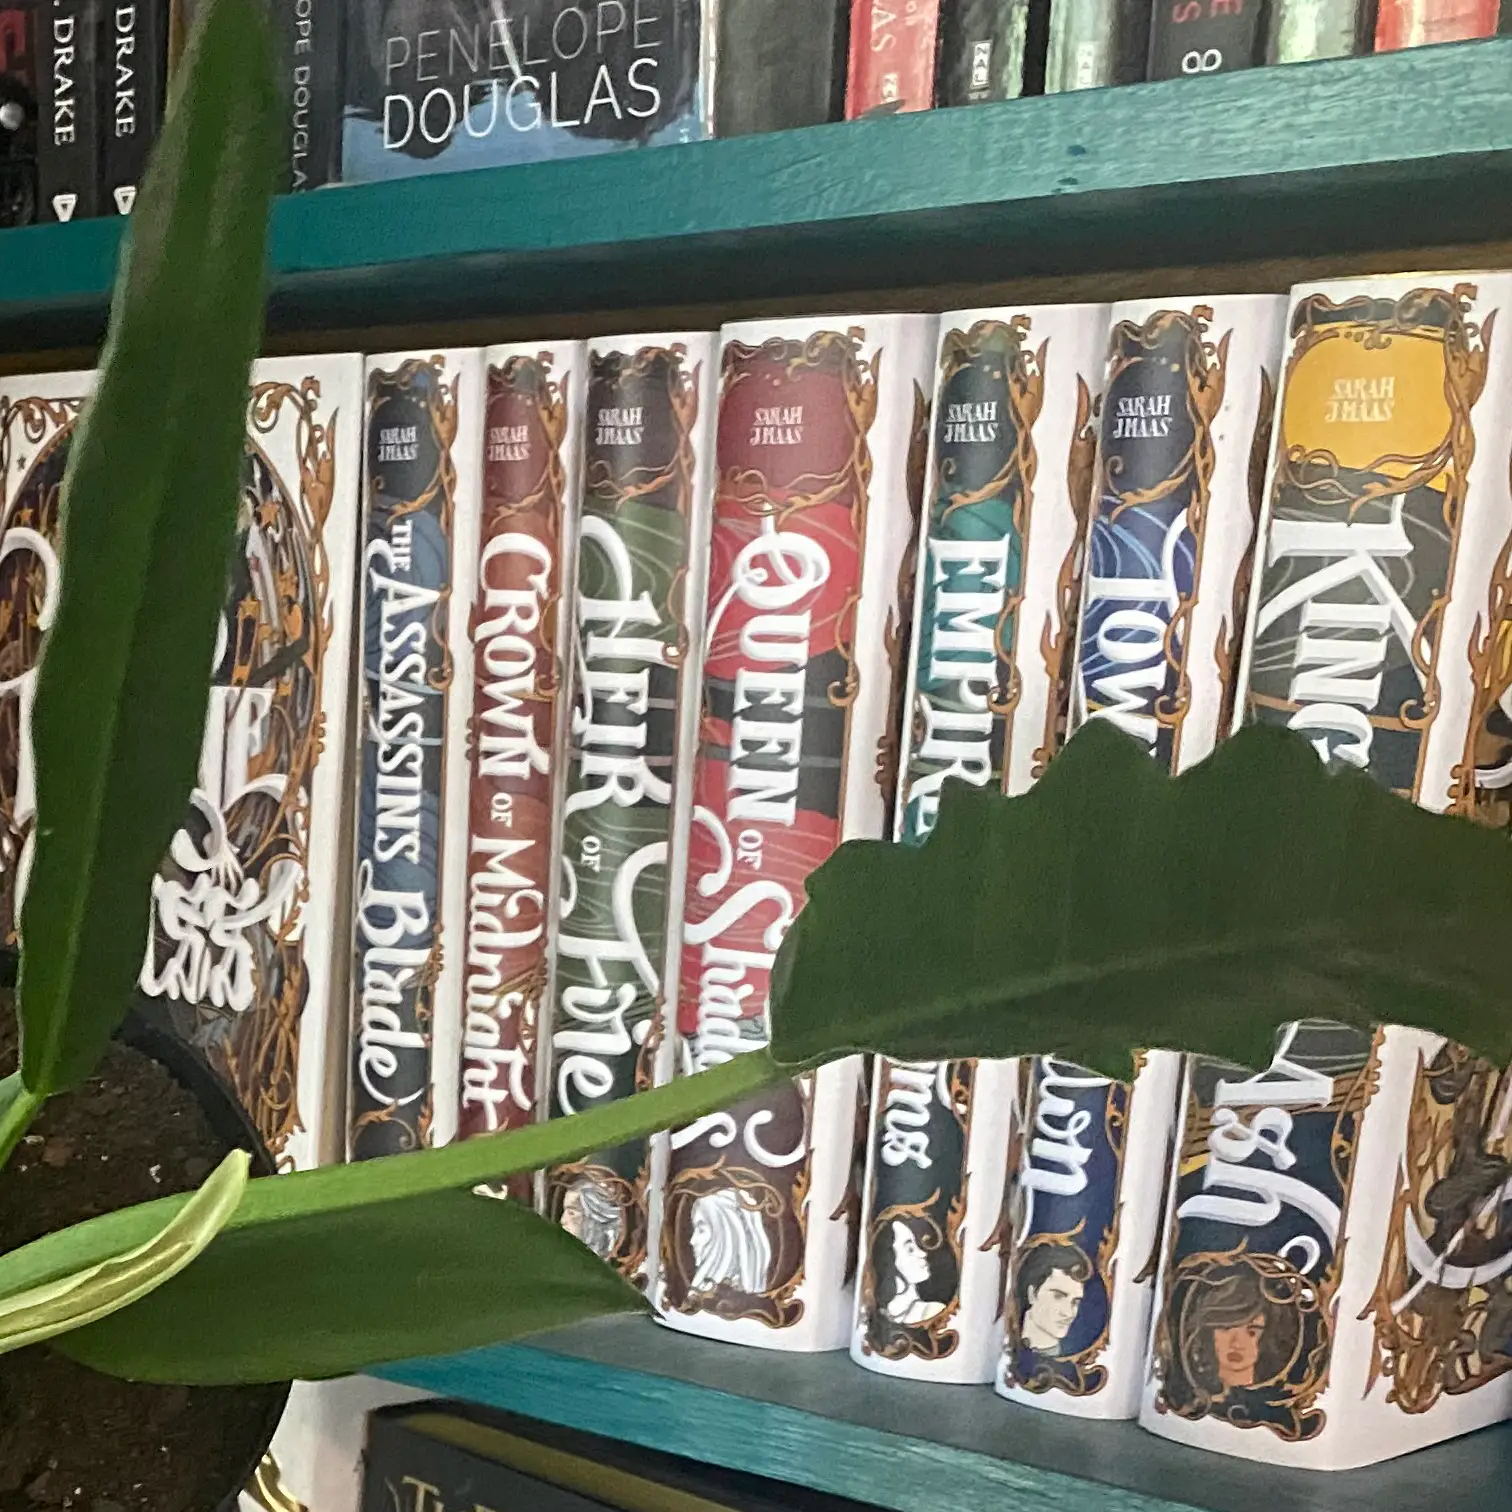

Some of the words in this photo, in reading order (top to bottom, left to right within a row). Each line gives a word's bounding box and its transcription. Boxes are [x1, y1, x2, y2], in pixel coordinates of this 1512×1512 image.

[52, 16, 76, 147] DRAKE
[115, 5, 136, 138] DRAKE
[382, 57, 661, 151] DOUGLAS
[386, 0, 663, 85] PENELOPE
[1116, 395, 1173, 417] SARAH
[1334, 377, 1396, 399] SARAH
[390, 520, 414, 573] THE
[473, 531, 552, 782] CROWN
[563, 513, 678, 819] HEIR
[704, 502, 831, 827] QUEEN
[1080, 505, 1189, 750] TOW
[1255, 493, 1438, 770] KING
[490, 791, 514, 828] OF
[580, 835, 601, 873] OF
[736, 829, 764, 871] OF
[357, 858, 433, 1108] Blade
[461, 834, 544, 1133] Midnight
[680, 804, 795, 1076] Shad
